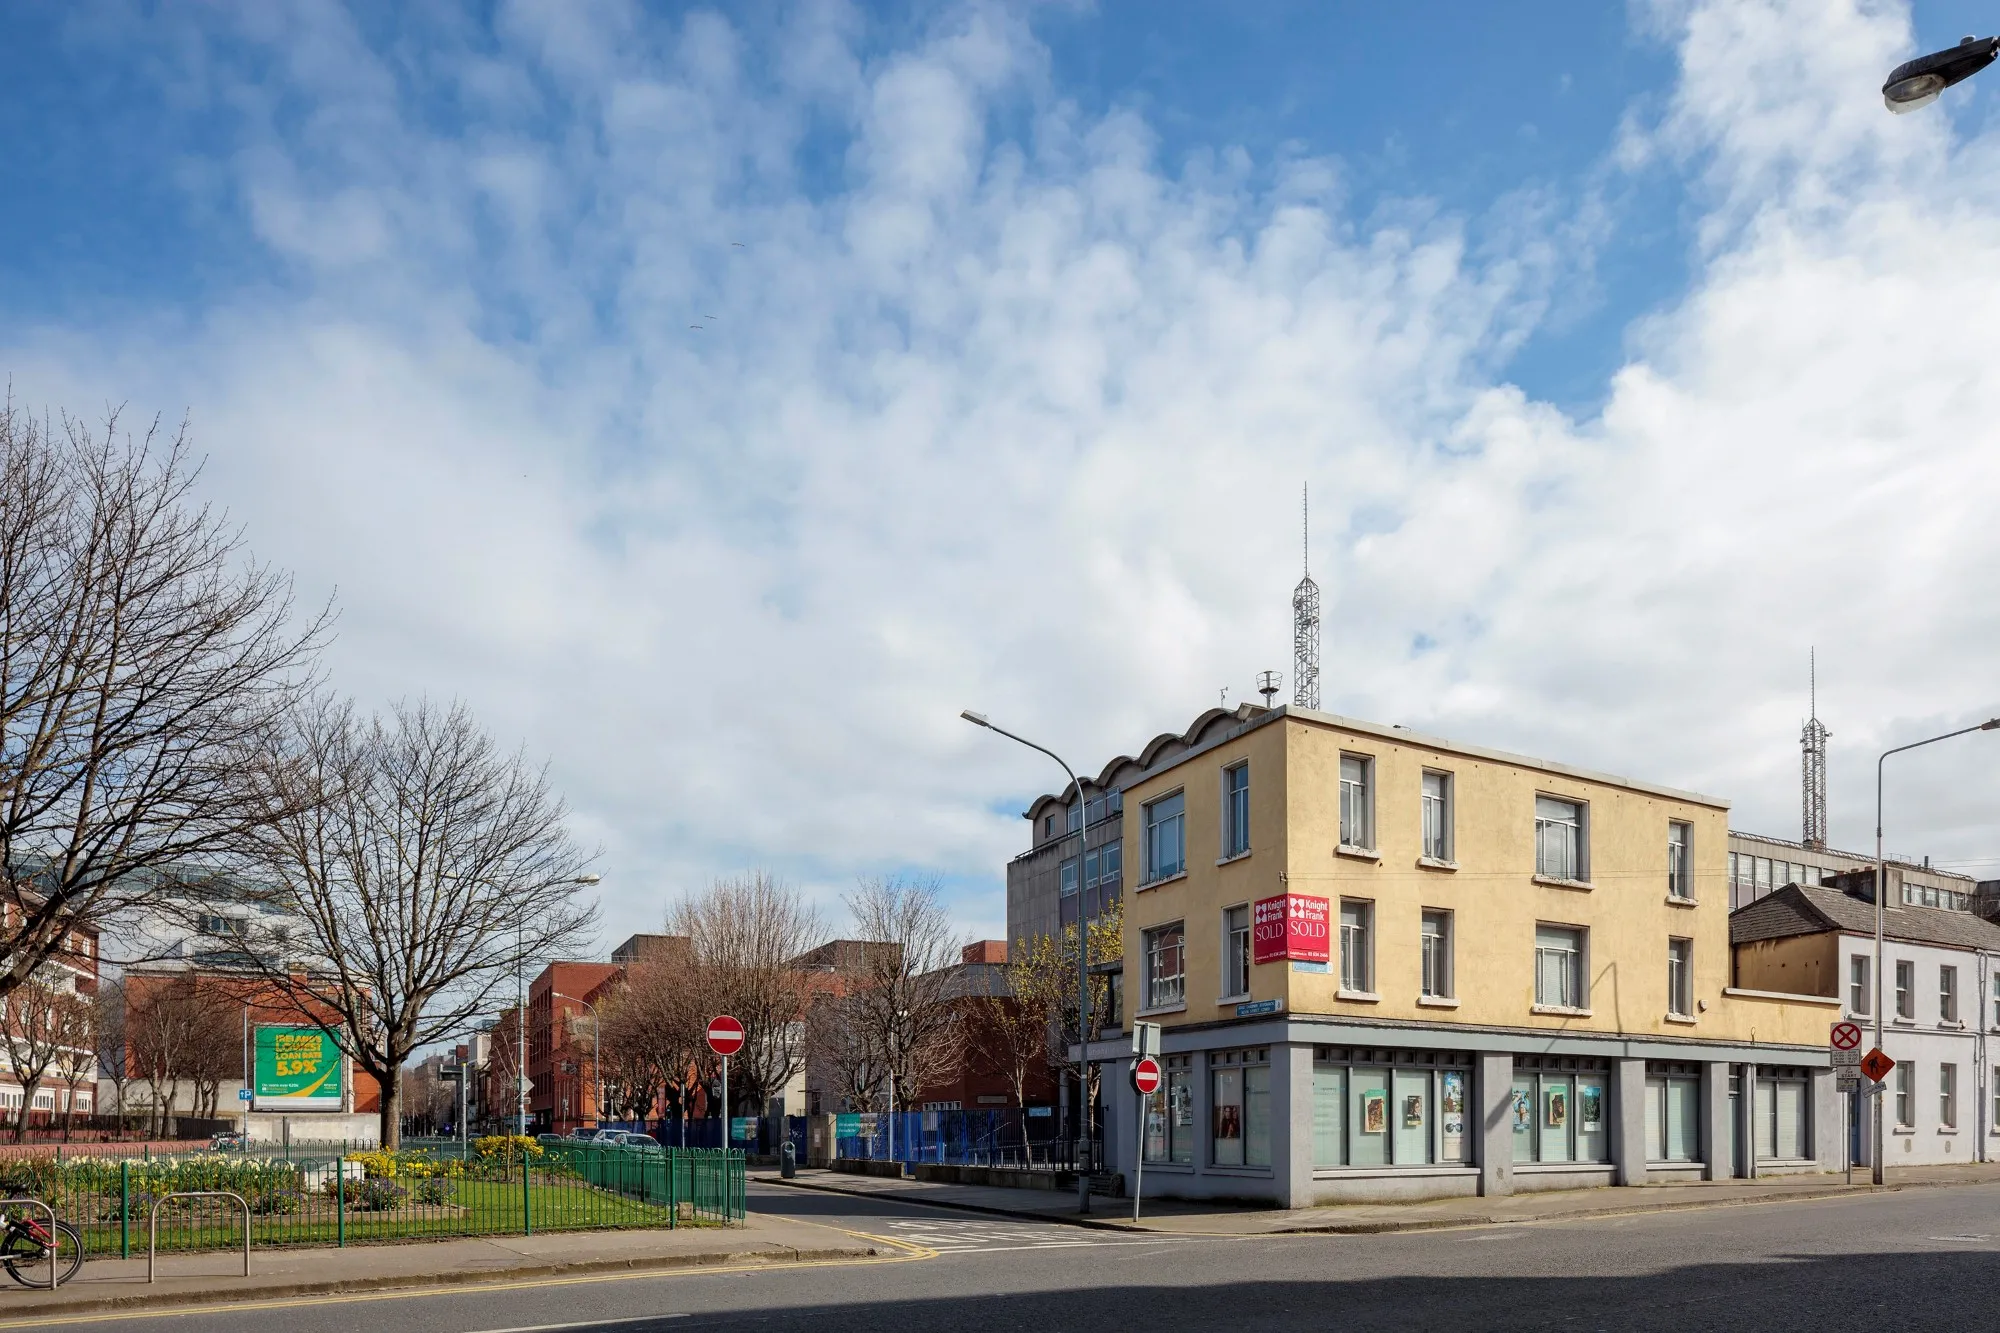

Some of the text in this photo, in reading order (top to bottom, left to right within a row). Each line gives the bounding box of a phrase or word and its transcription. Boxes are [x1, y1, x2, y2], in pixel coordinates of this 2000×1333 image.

[1268, 899, 1286, 912] Knight
[1306, 899, 1328, 912] Knight
[1268, 911, 1283, 921] Frank
[1306, 910, 1325, 921] Frank
[1256, 923, 1283, 941] SOLD
[1291, 921, 1325, 937] SOLD
[276, 1042, 322, 1052] LOWEST
[276, 1051, 322, 1060] LOAN RATE
[276, 1060, 317, 1076] 5.9%
